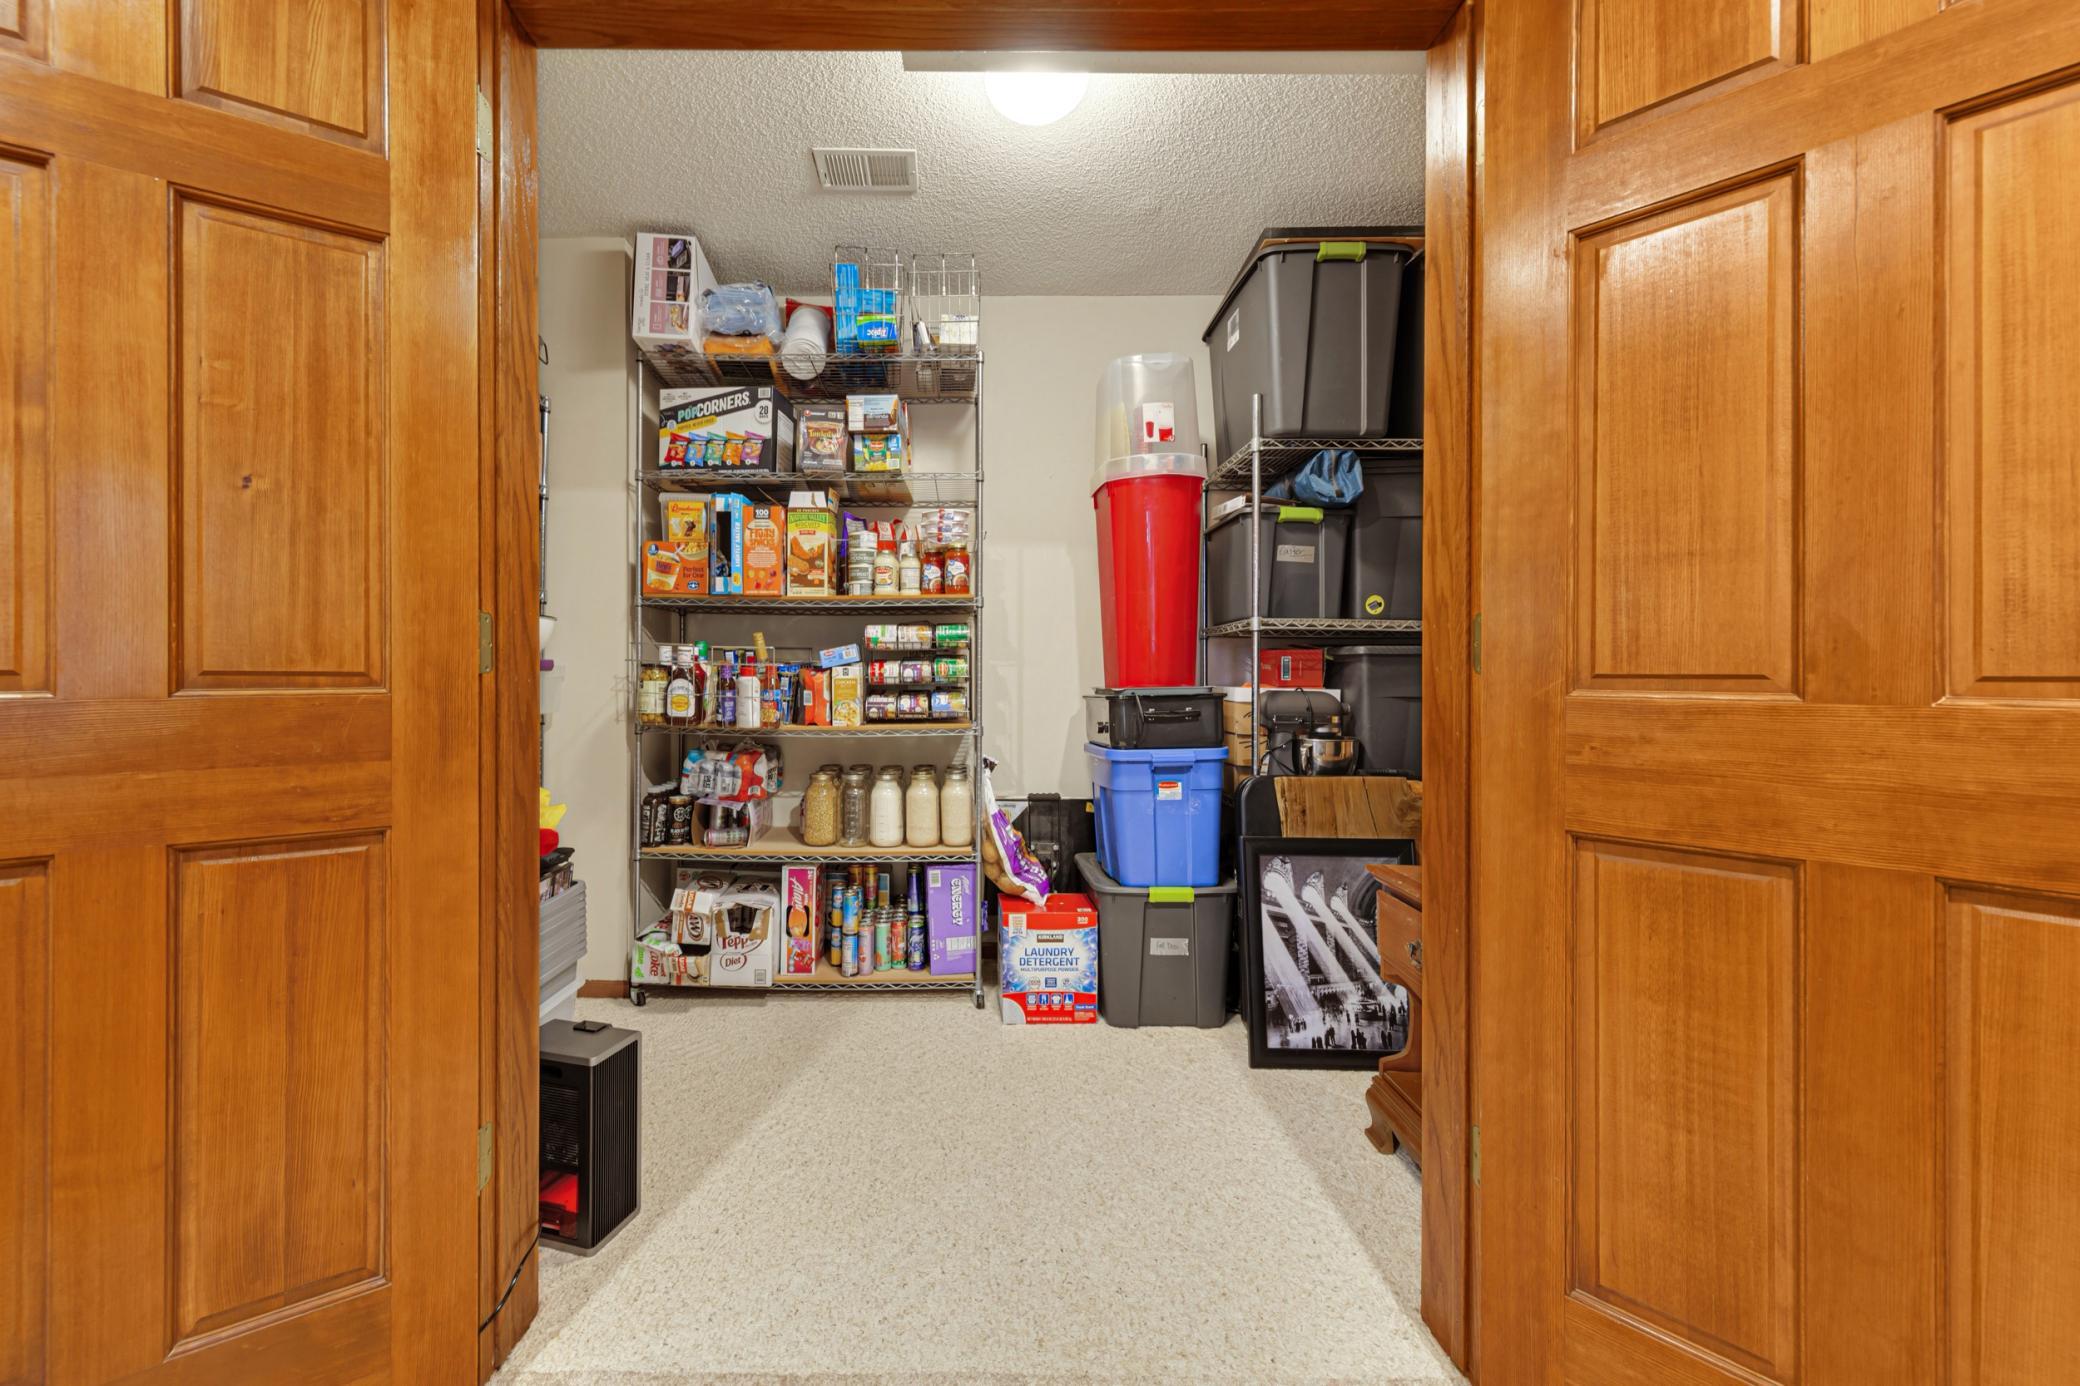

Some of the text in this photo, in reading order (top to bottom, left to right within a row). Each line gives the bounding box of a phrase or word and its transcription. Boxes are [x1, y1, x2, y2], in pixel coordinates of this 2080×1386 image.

[1024, 947, 1074, 957] LAUNDRY
[725, 955, 741, 968] Diet
[1019, 957, 1080, 967] DETERGENT
